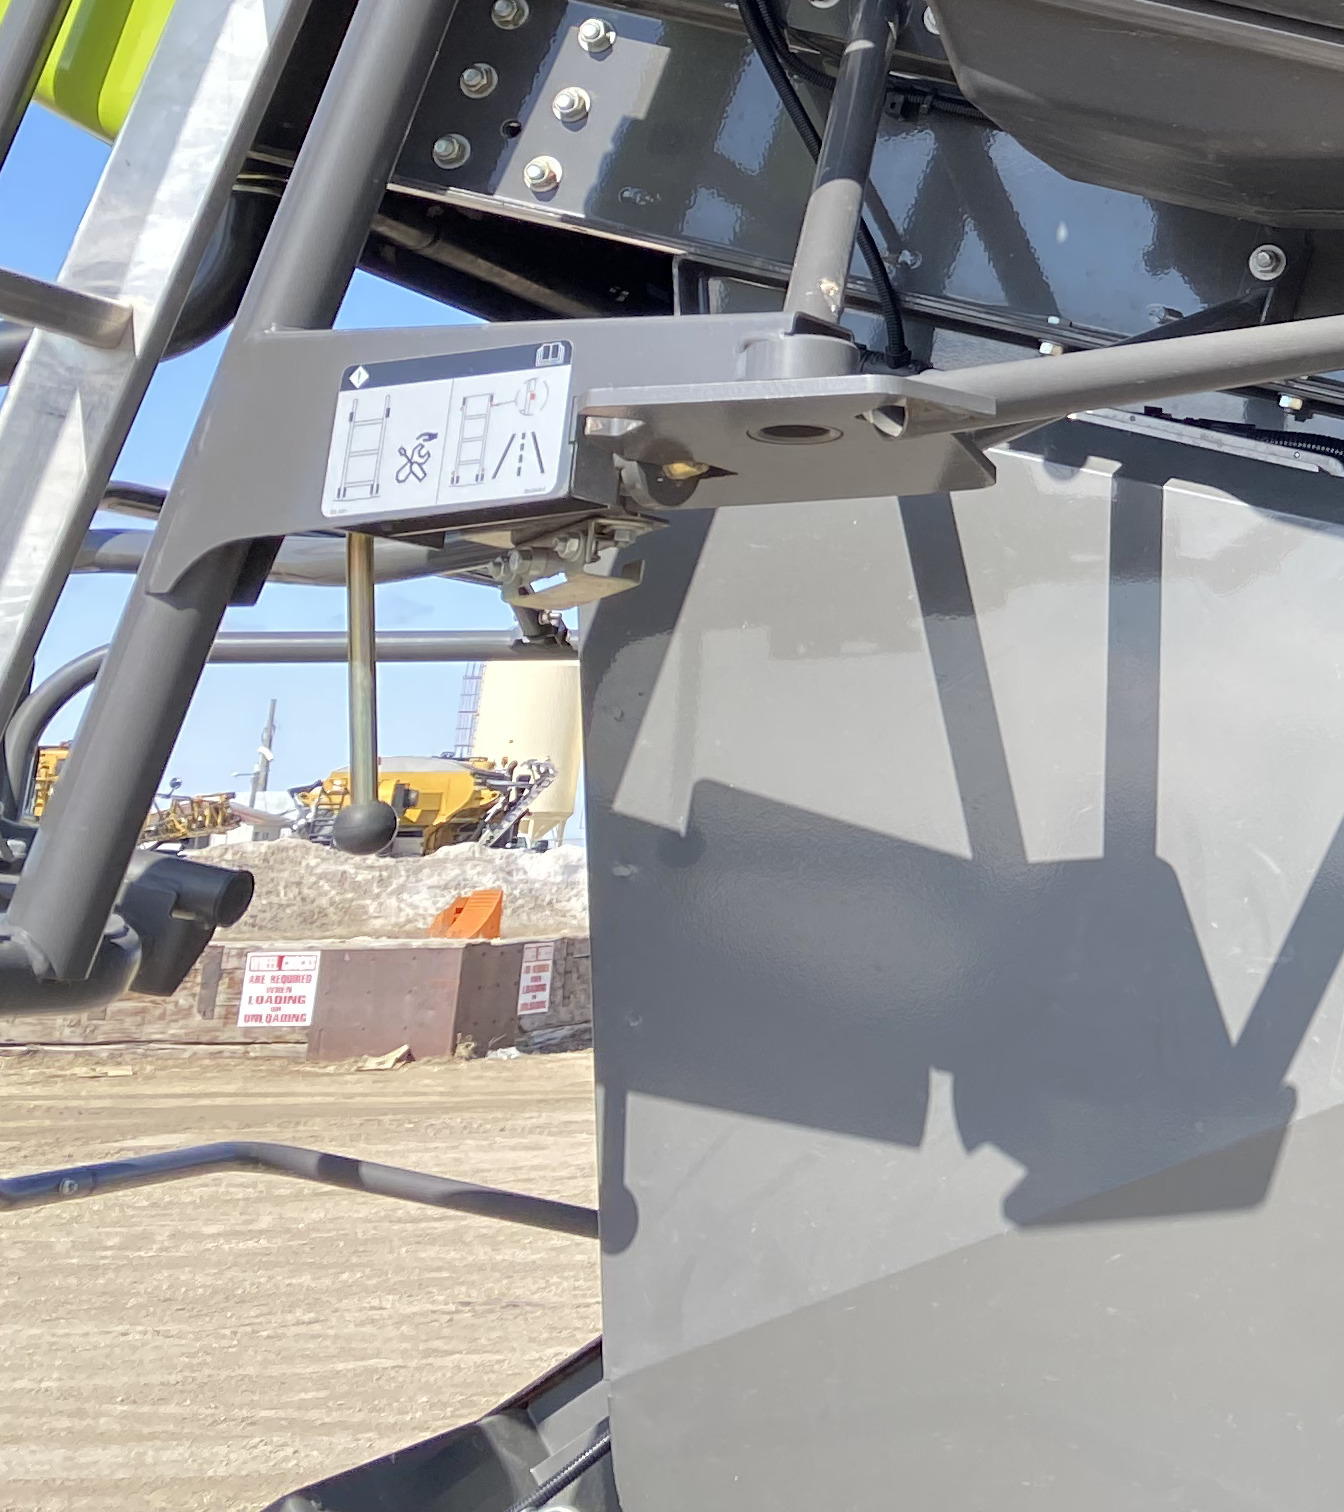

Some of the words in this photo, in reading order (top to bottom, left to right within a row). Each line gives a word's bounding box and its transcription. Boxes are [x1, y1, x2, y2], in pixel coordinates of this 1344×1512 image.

[270, 974, 313, 984] REQUIRED
[248, 995, 307, 1005] LOADING
[243, 1013, 307, 1024] UNLOADING
